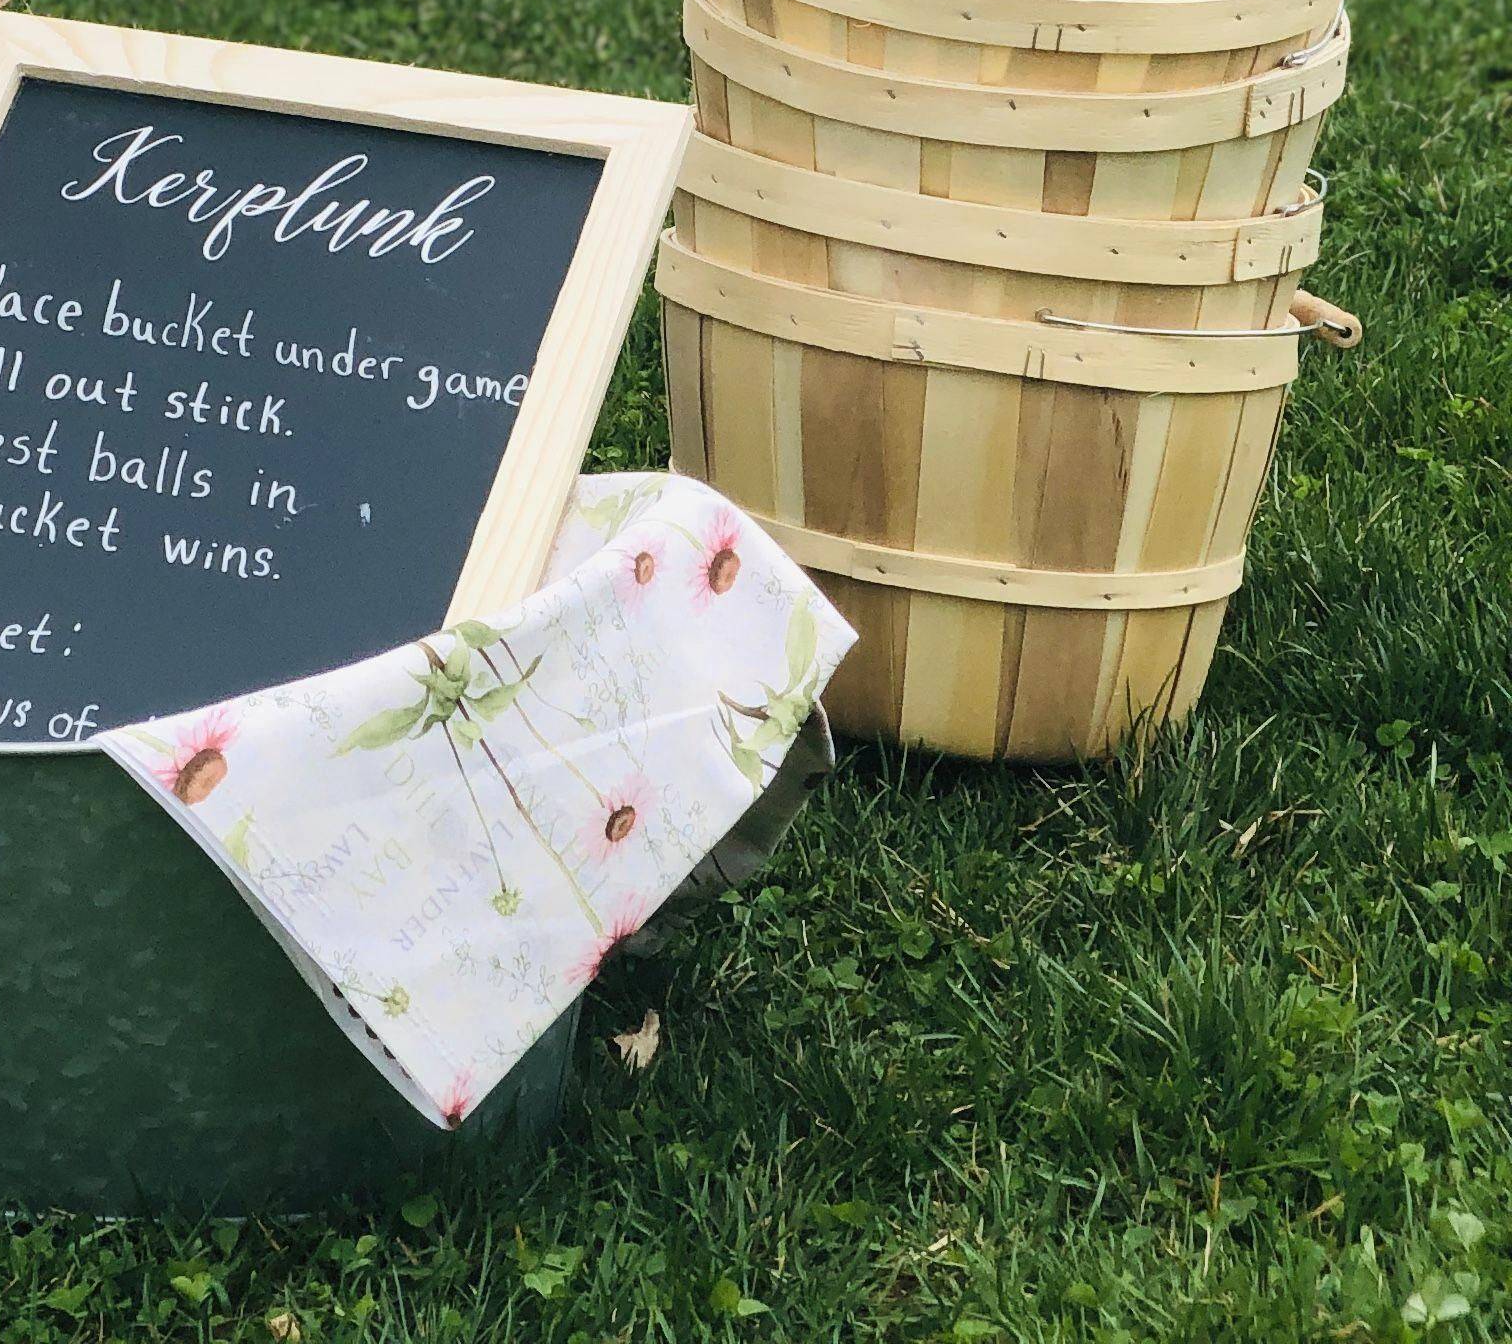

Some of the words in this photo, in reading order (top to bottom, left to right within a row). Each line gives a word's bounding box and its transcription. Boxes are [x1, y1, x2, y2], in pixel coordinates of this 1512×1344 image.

[61, 125, 497, 265] Kerplunk
[102, 278, 255, 357] bucket
[275, 327, 404, 380] under
[406, 364, 528, 410] game
[45, 371, 138, 412] out
[164, 381, 293, 437] stick.
[88, 431, 214, 498] balls
[250, 468, 298, 515] in
[164, 534, 280, 580] wins.
[48, 704, 100, 742] of
